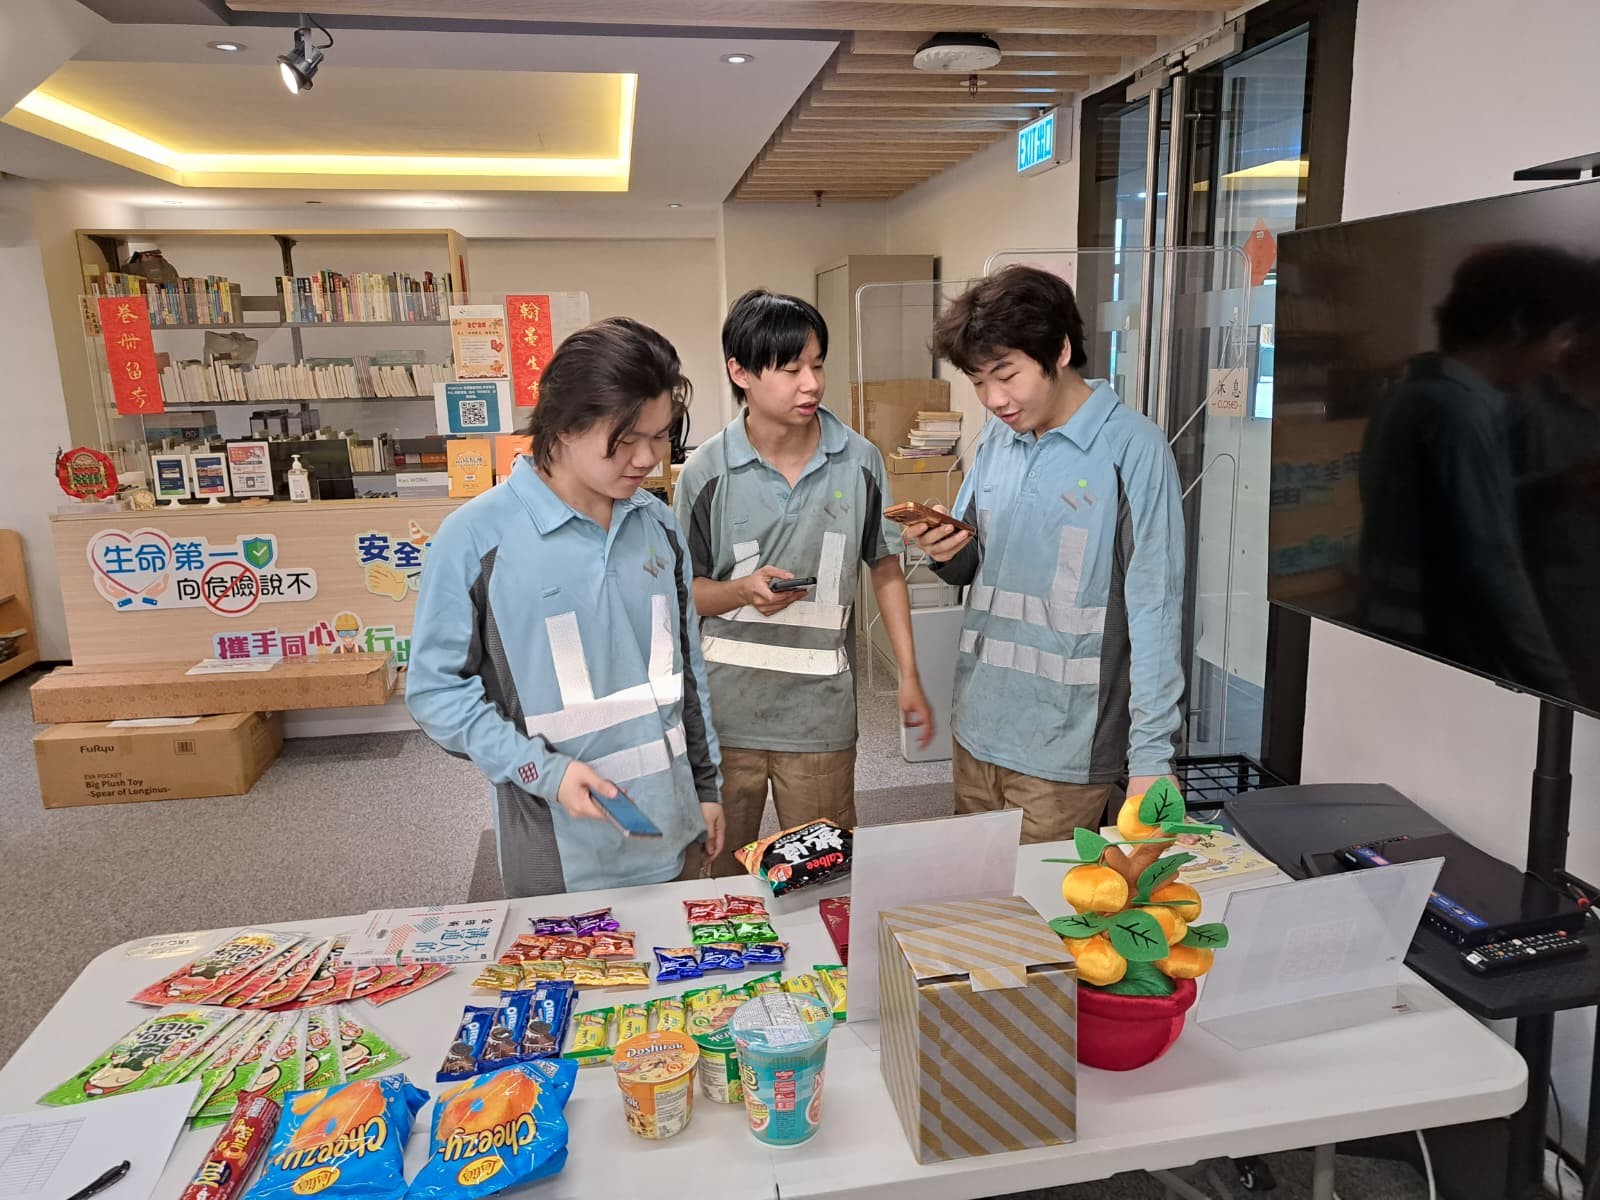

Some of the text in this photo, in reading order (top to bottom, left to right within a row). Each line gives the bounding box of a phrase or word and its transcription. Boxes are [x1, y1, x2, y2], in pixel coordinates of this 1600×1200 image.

[1019, 127, 1037, 170] EXIT
[103, 541, 239, 575] 生命第一
[358, 533, 422, 568] 安全
[176, 572, 312, 601] 向危險說不
[216, 621, 337, 660] 攜手同心
[79, 744, 115, 754] FuRyu
[85, 779, 144, 790] Big Plush Toy
[117, 788, 127, 796] of
[806, 851, 844, 870] Calbee
[625, 1042, 684, 1059] Doshirak
